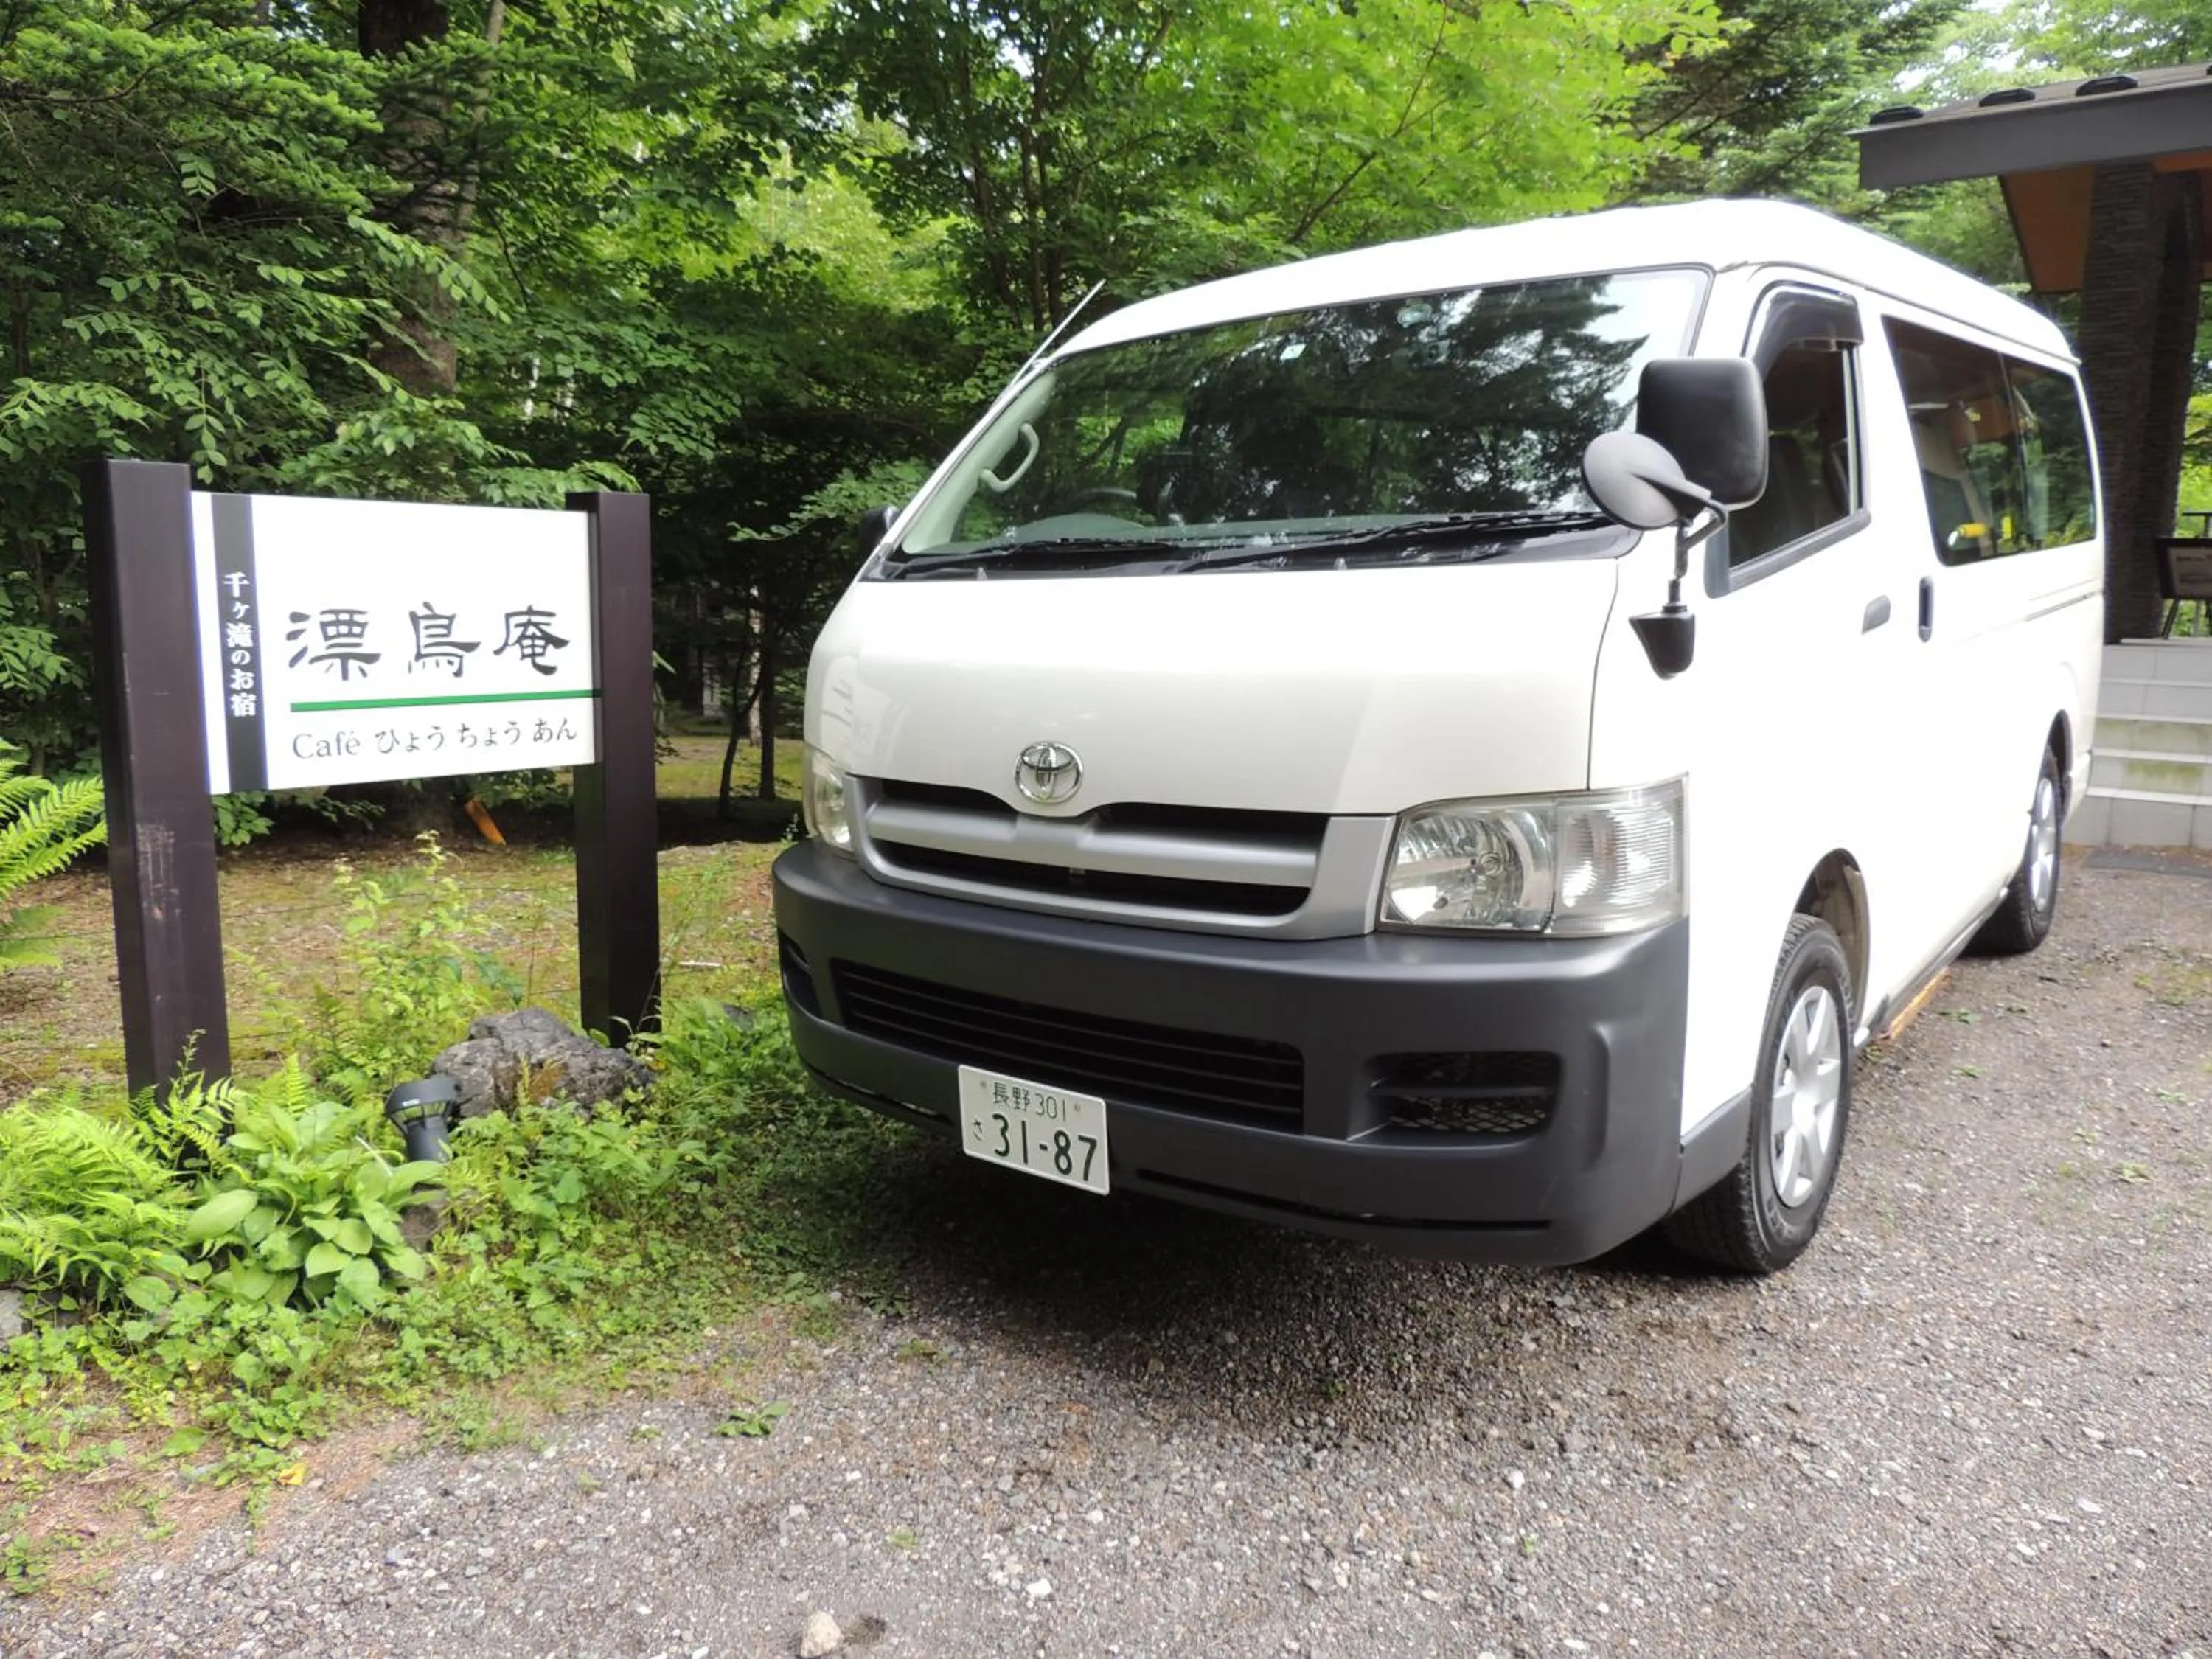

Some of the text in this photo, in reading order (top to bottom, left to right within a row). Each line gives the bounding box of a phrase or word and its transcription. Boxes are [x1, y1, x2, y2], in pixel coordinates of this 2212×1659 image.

[285, 601, 570, 681] 漂鳥庵
[292, 730, 361, 759] Café
[992, 1113, 1097, 1182] 31-87
